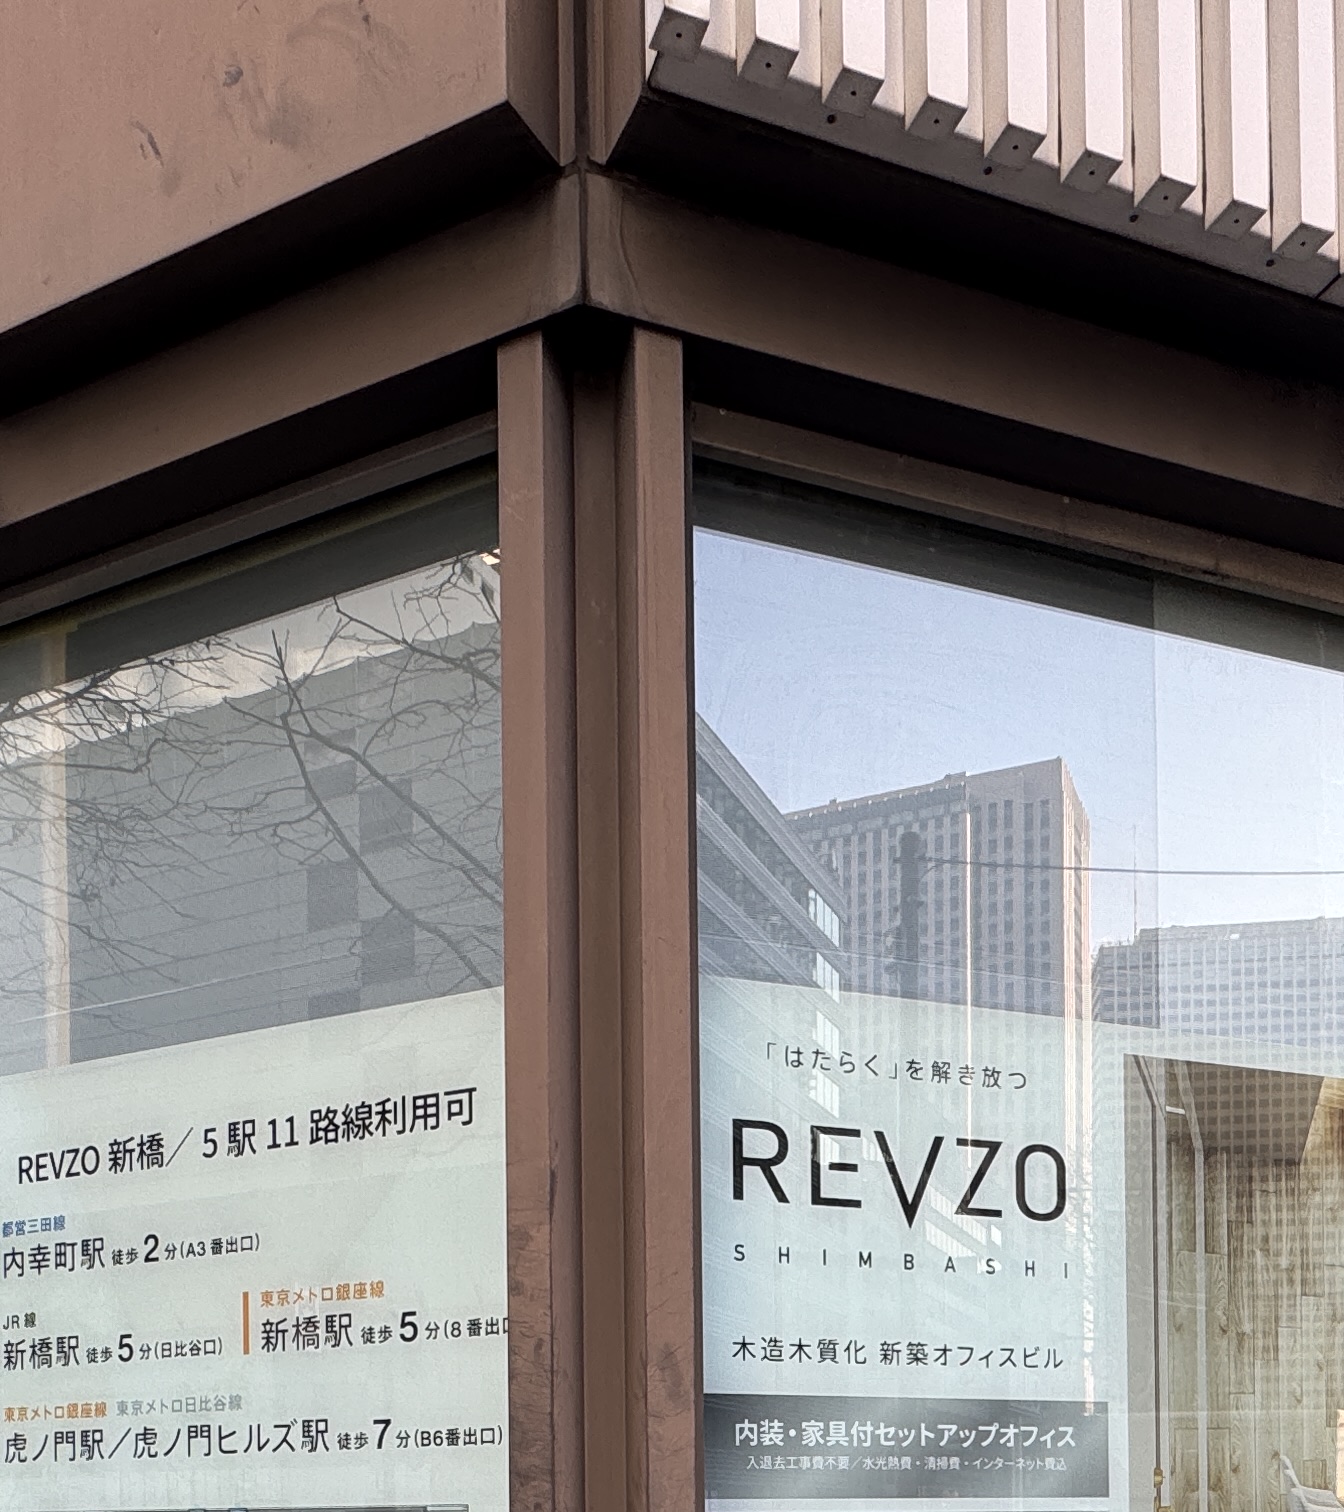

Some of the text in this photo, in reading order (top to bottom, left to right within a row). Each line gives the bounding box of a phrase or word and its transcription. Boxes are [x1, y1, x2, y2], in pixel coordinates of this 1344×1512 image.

[766, 1041, 1028, 1091] 「はたらく」を解き放つ
[17, 1145, 101, 1185] REVZO
[731, 1117, 1067, 1230] REVZO
[2, 1215, 67, 1238] 都営三田線
[3, 1237, 106, 1279] 内幸町駅
[733, 1243, 1069, 1280] SHIMBASHI
[259, 1280, 386, 1309] 東京メトロ銀座線
[260, 1312, 354, 1354] 新橋駅
[3, 1335, 80, 1371] 新橋駅
[731, 1335, 1064, 1370] 木造木質化 新築オフィスビル
[3, 1393, 243, 1423] 東京メトロ銀座線 東京メトロ日比谷線
[4, 1418, 330, 1464] 虎ノ門駅／虎ノ門ヒルズ駅
[734, 1419, 1077, 1449] 内装・家具付セットアップオフィス
